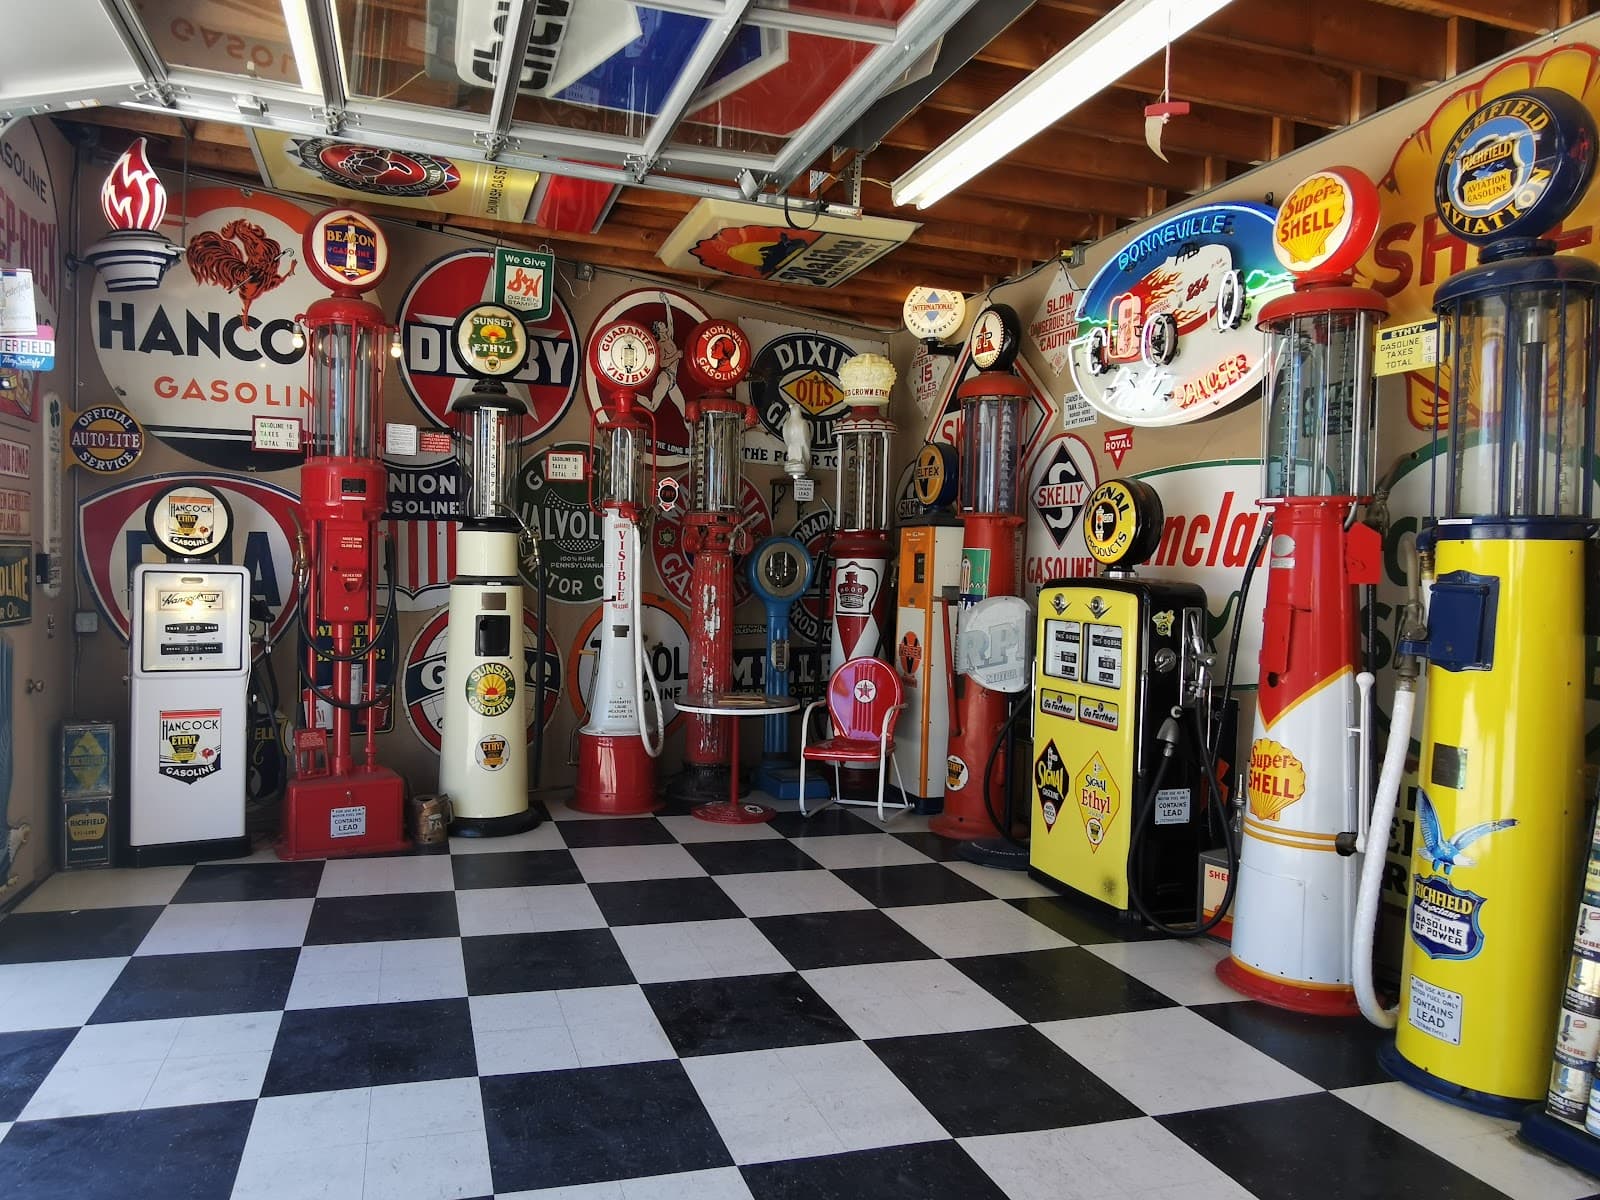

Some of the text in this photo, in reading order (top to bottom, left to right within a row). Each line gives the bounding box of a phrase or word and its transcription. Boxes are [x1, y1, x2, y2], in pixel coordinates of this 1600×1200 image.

[1446, 100, 1549, 165] RICHFIELD
[1461, 142, 1514, 171] RICHFIELD
[1466, 183, 1509, 203] GASOLINE
[1467, 173, 1508, 194] AVIATION
[1281, 211, 1335, 243] SHELL
[326, 229, 376, 249] BEACON
[1118, 215, 1227, 271] BONNEVILLE
[504, 253, 547, 268] We Give
[912, 302, 954, 312] INTERNATIONAL
[1046, 292, 1075, 314] SLOW
[99, 300, 306, 365] HANCO
[473, 317, 514, 328] SUNSET
[1030, 314, 1065, 337] DANGEROUS
[1391, 325, 1426, 338] ETHYL
[601, 325, 656, 357] GUARANTEE
[701, 325, 744, 346] MOHAWK
[1040, 327, 1079, 352] CAUTION
[1380, 337, 1420, 352] GASOLINE
[474, 343, 513, 354] ETHYL
[1387, 347, 1414, 359] TAXES
[606, 362, 651, 384] VISIBLE
[699, 357, 743, 381] GASOLINE
[1385, 358, 1412, 369] TOTAL
[795, 379, 834, 407] OILS
[852, 388, 874, 397] CROWN
[79, 408, 133, 429] OFFICIAL
[743, 447, 768, 462] THE
[1105, 438, 1132, 451] ROYAL
[79, 452, 134, 471] SERVICE
[389, 472, 456, 495] NION
[1037, 483, 1084, 507] SKELLY
[1086, 486, 1131, 521] SIGNAL
[168, 503, 213, 518] HANCOCK
[173, 537, 209, 547] GASOLINE
[1086, 530, 1127, 558] PRODUCTS
[617, 530, 626, 601] VISIBLE
[471, 663, 513, 683] SUNSET
[469, 695, 513, 716] GASOLINE
[1083, 707, 1116, 723] Go Farther
[162, 719, 219, 741] HANCOCK
[172, 735, 197, 746] ETHYL
[482, 742, 504, 752] ETHYL
[166, 764, 216, 778] GASOLINE
[1037, 760, 1064, 801] SIGNAL
[1085, 774, 1107, 794] SIGNAL
[1248, 769, 1295, 800] SHELL
[1081, 788, 1111, 814] Ethyl
[1158, 801, 1187, 809] CONTAINS
[70, 817, 106, 827] RICHFIELD
[1163, 809, 1183, 817] LEAD
[338, 823, 358, 832] LEAD
[1415, 881, 1473, 915] RICHFIELD
[1415, 912, 1463, 938] GASOLINE
[1415, 921, 1463, 947] OF POWER
[1412, 995, 1454, 1020] CONTAINS
[1426, 991, 1441, 1003] FUEL
[1442, 999, 1458, 1009] ONLY
[1416, 1008, 1446, 1029] LEAD
